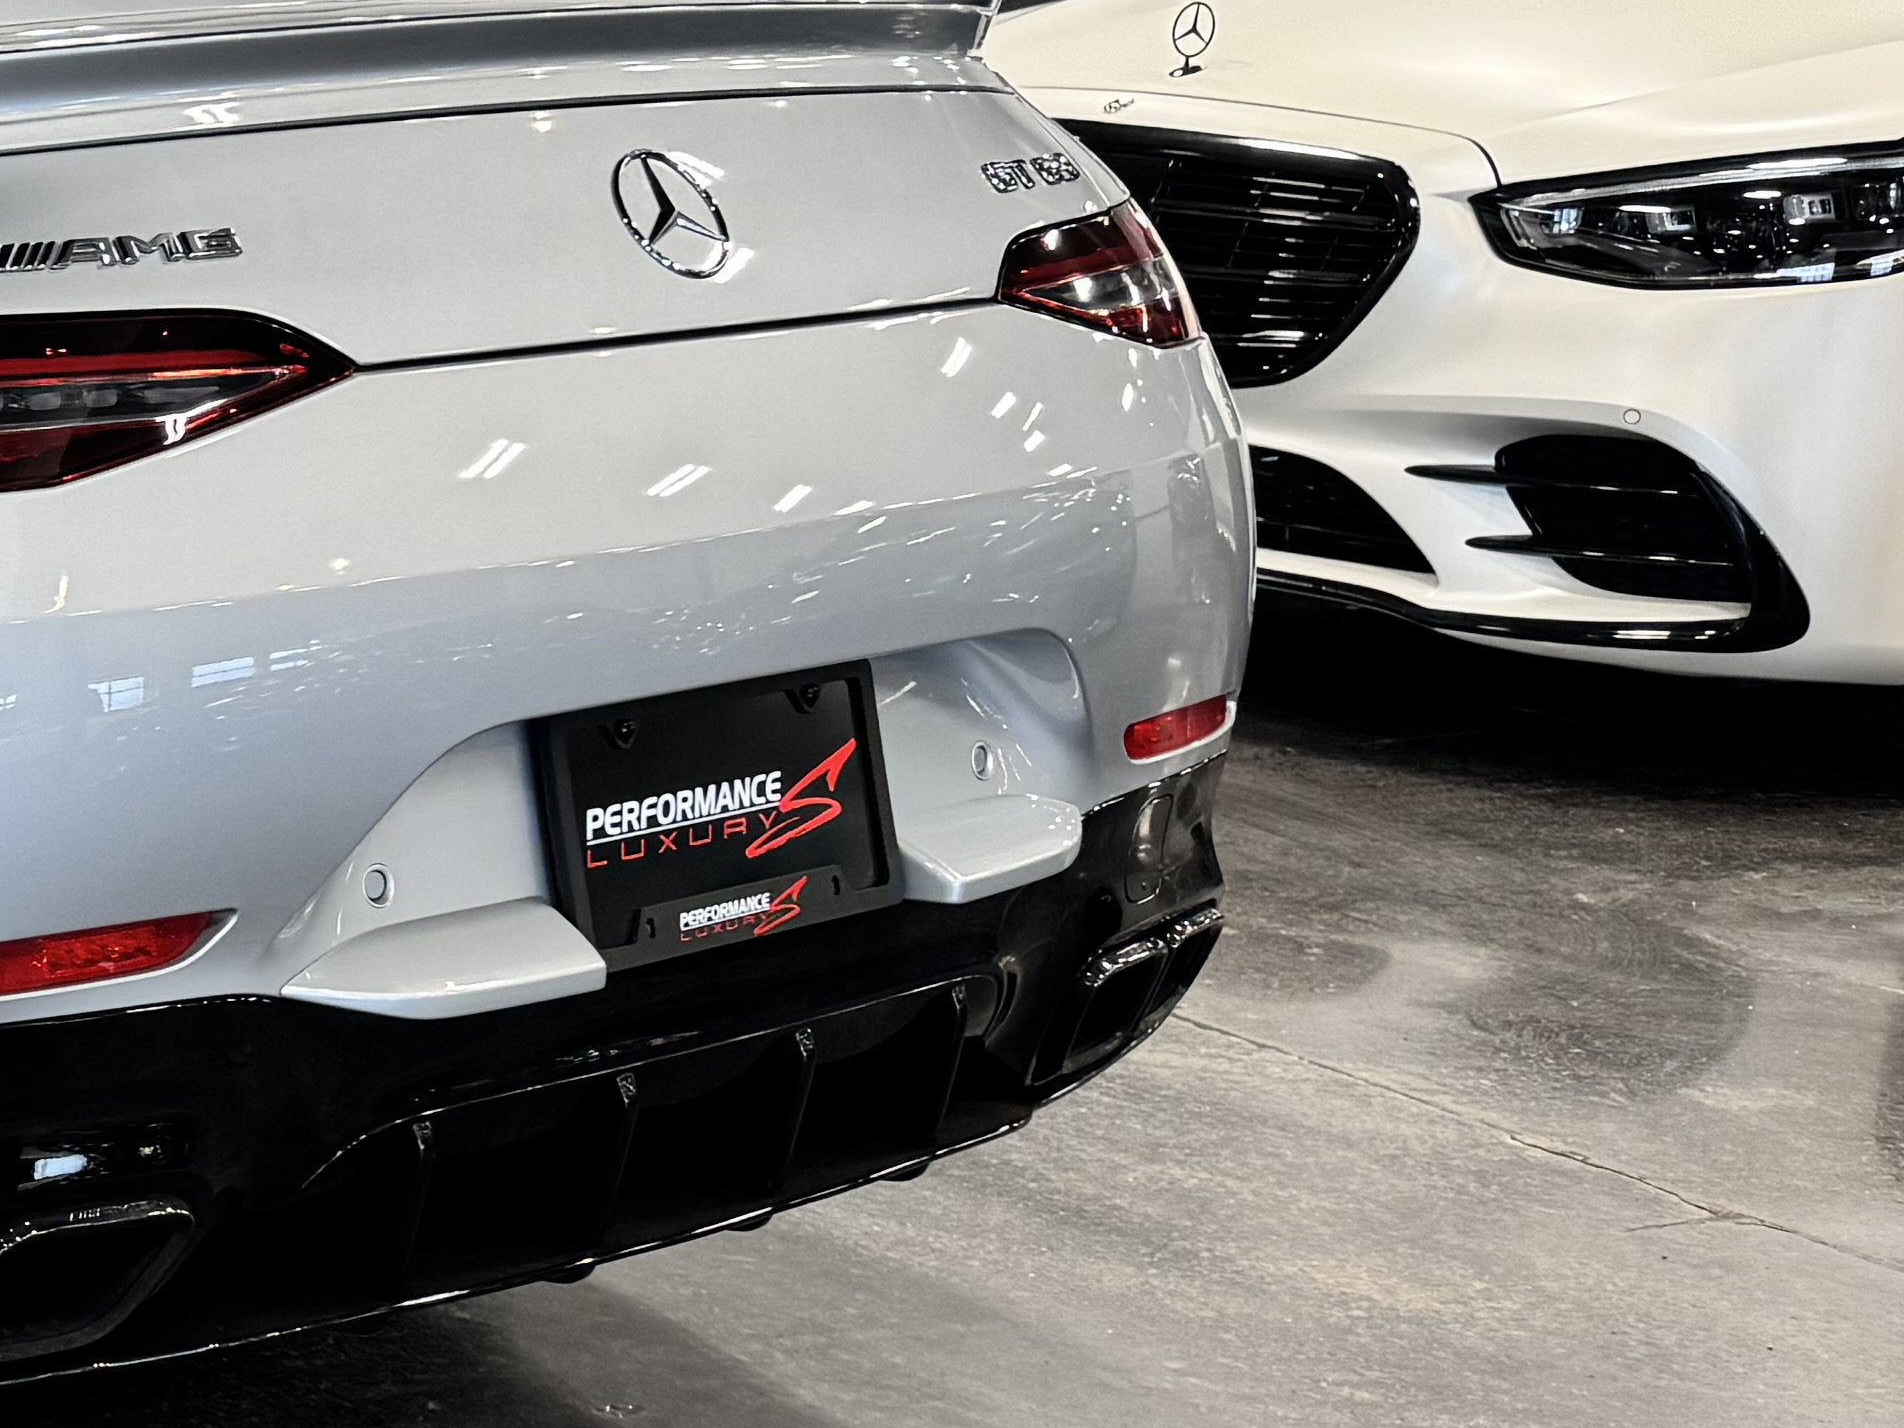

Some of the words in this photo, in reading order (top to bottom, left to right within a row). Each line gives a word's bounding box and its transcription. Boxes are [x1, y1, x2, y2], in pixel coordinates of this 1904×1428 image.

[49, 227, 243, 270] AMG
[586, 770, 782, 841] PERFORMANCE
[587, 810, 778, 868] LUXURY
[680, 892, 771, 927] PERFORMANCE
[680, 914, 773, 941] LUXURY
